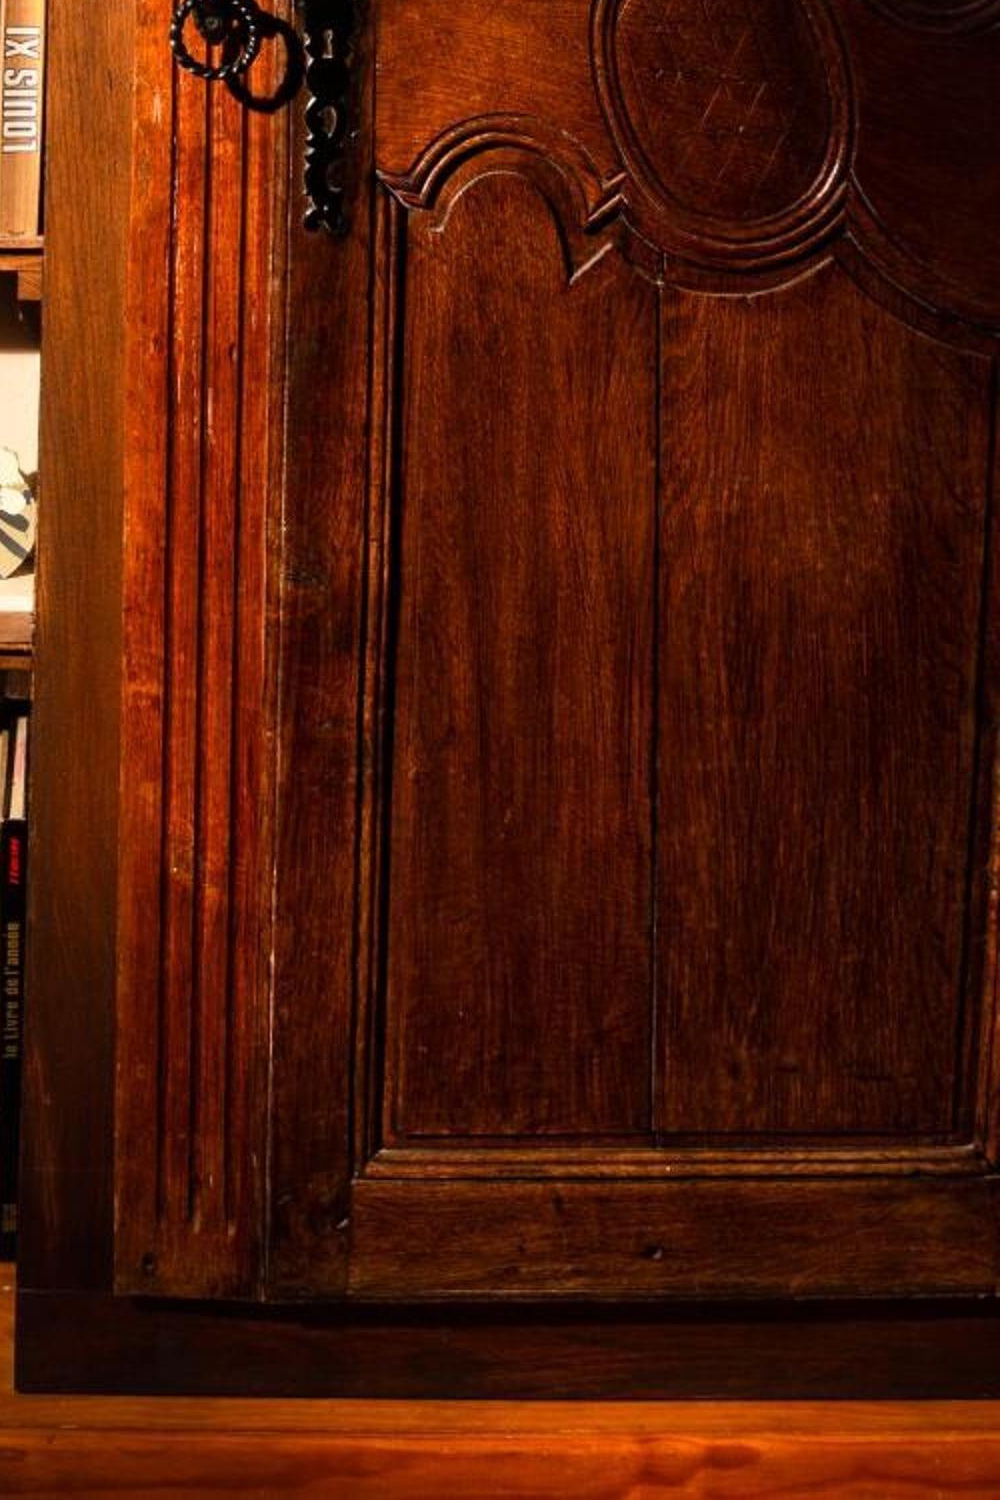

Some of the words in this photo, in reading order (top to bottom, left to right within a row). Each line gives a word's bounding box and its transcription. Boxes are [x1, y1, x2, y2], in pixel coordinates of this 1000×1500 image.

[4, 25, 40, 59] XI
[2, 67, 40, 153] LOUIS
[1, 921, 20, 976] l'année
[1, 979, 19, 996] de
[1, 1000, 19, 1040] Livre
